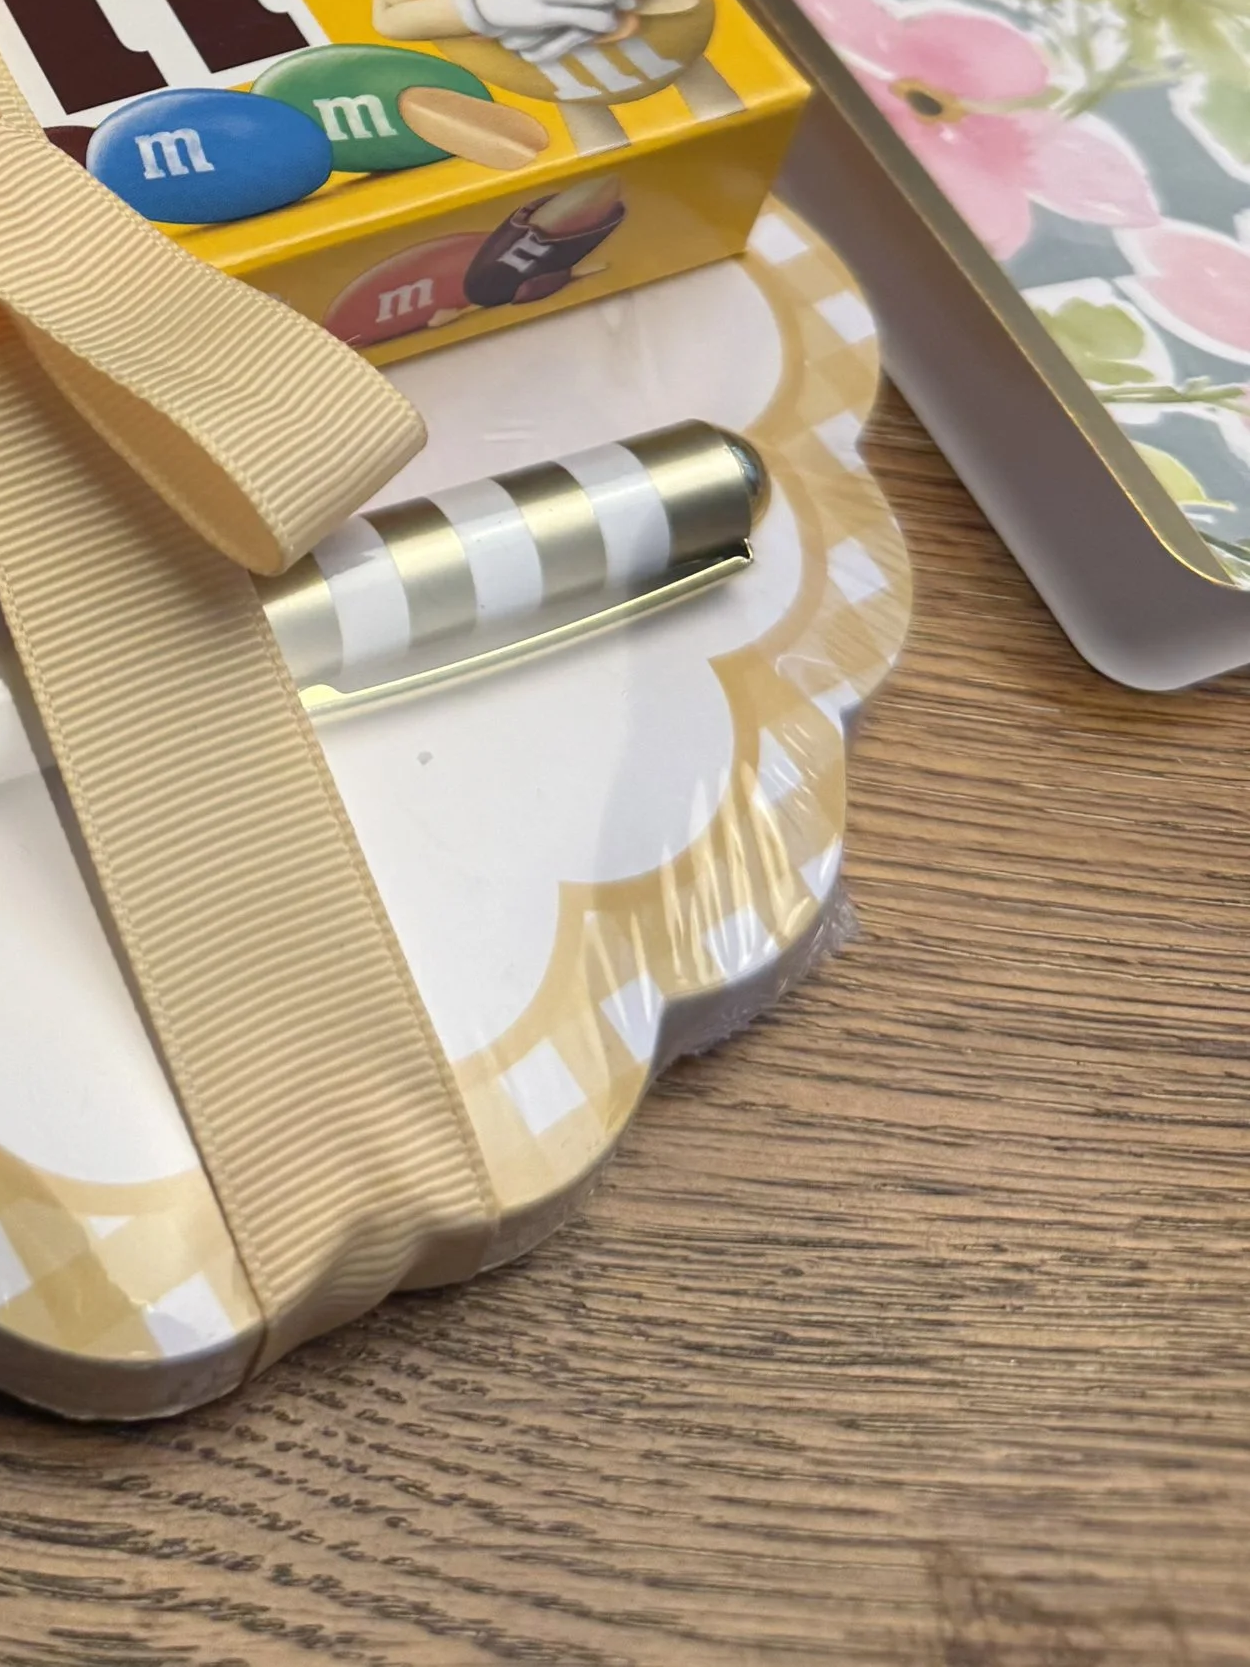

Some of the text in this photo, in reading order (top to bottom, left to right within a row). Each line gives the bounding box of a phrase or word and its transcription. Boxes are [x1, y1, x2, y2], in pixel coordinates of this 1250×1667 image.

[312, 93, 398, 141] m
[135, 125, 216, 180] m
[375, 277, 435, 324] m
